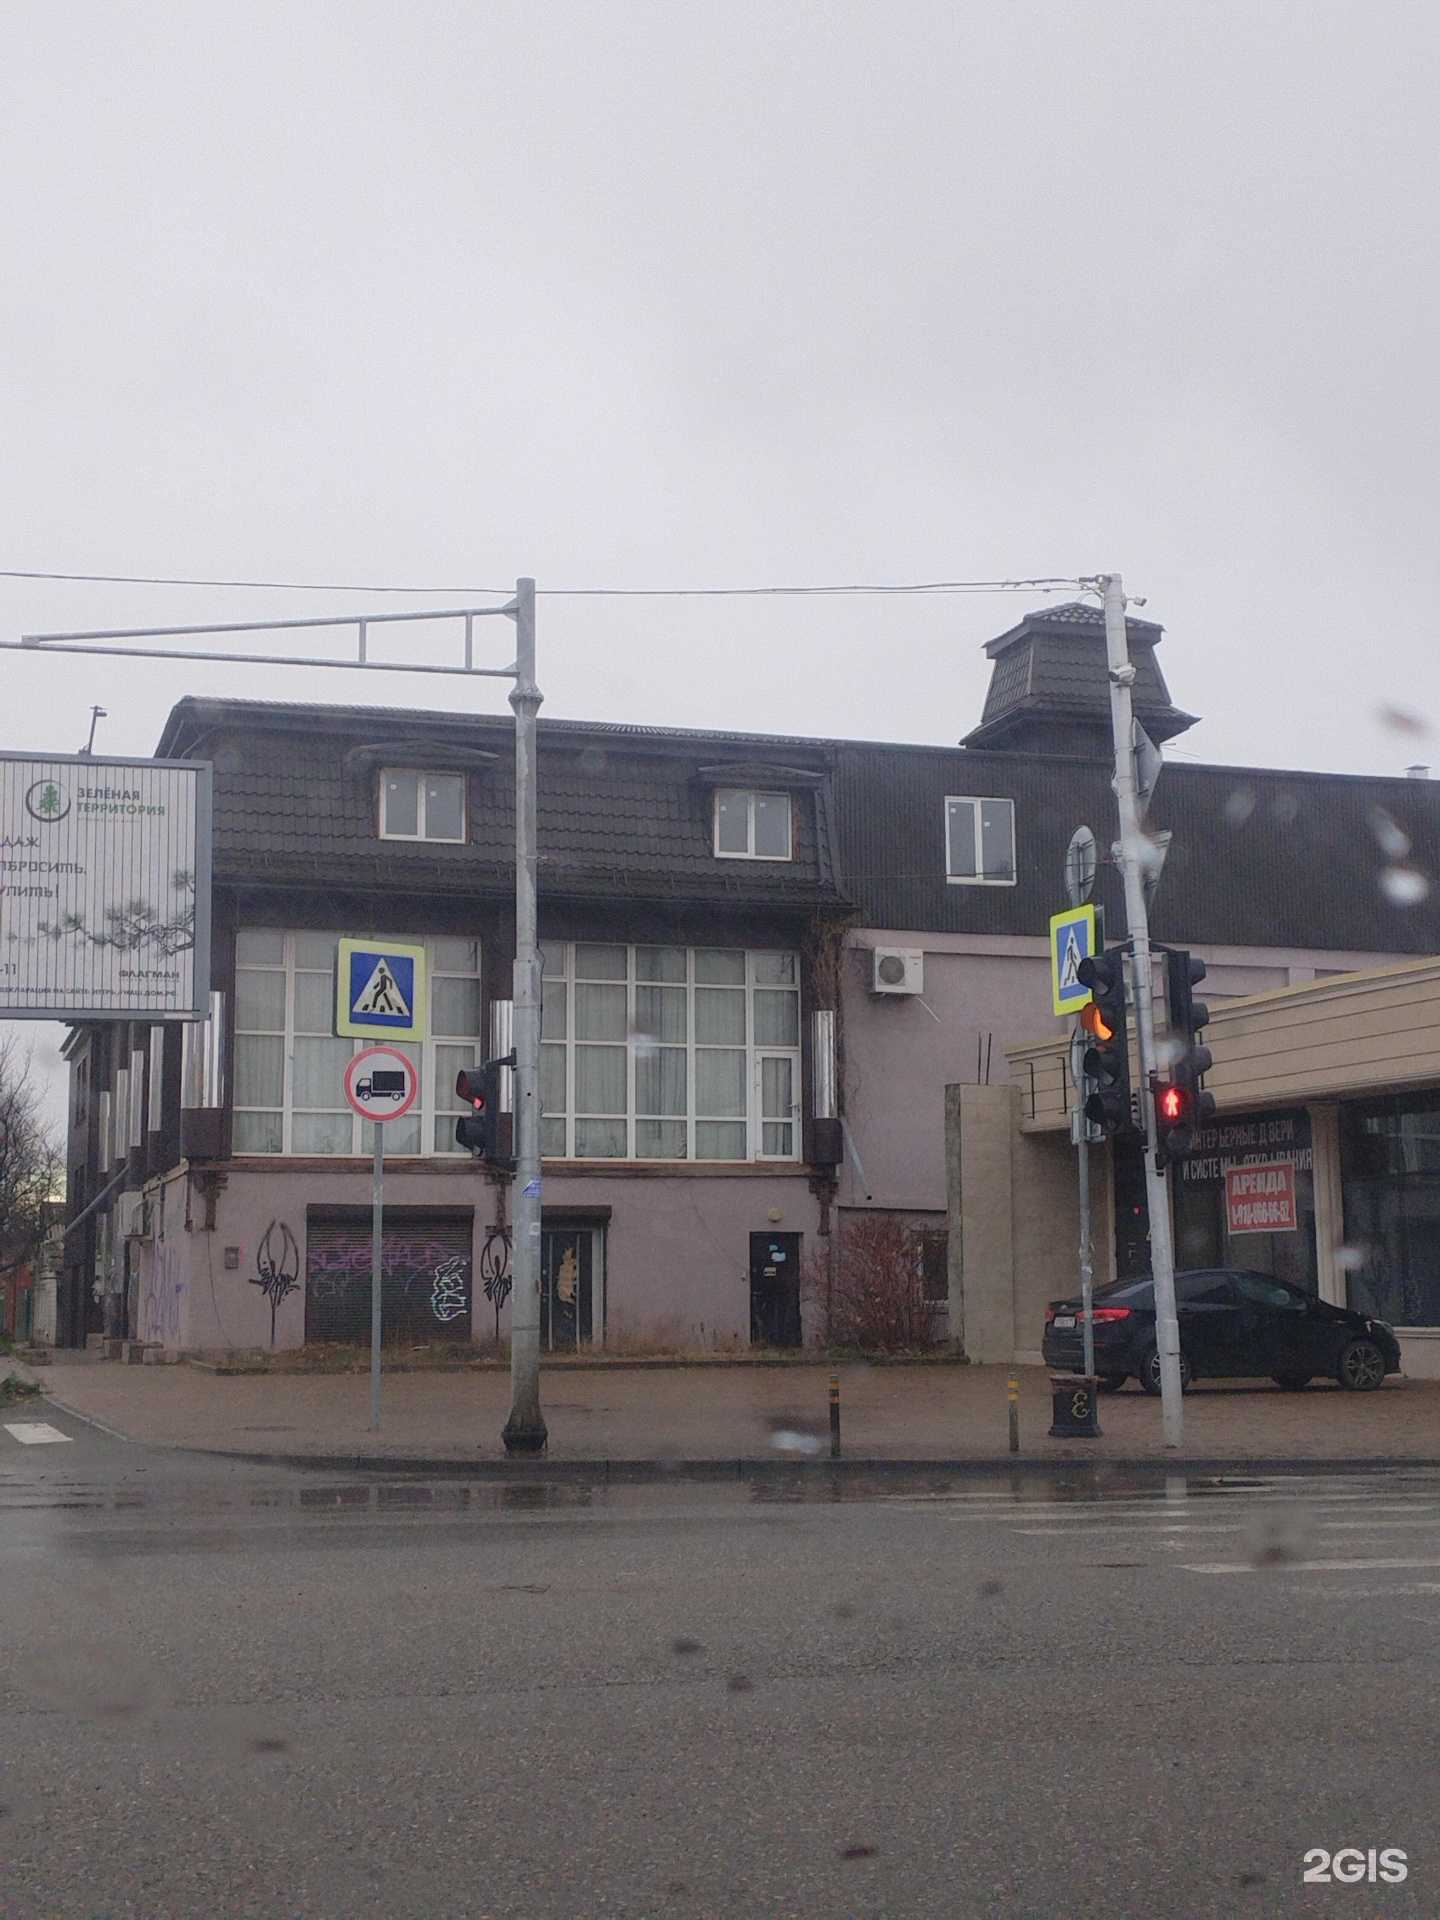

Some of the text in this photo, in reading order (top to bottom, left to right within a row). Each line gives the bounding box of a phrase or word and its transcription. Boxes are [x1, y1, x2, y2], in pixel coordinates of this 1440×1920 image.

[77, 787, 140, 800] ЗЕЛЁНАЯ
[77, 802, 165, 816] ТЕРРИТОРИЯ
[118, 969, 180, 979] ФЛАГМАН
[1232, 1171, 1287, 1196] АРЕНДА
